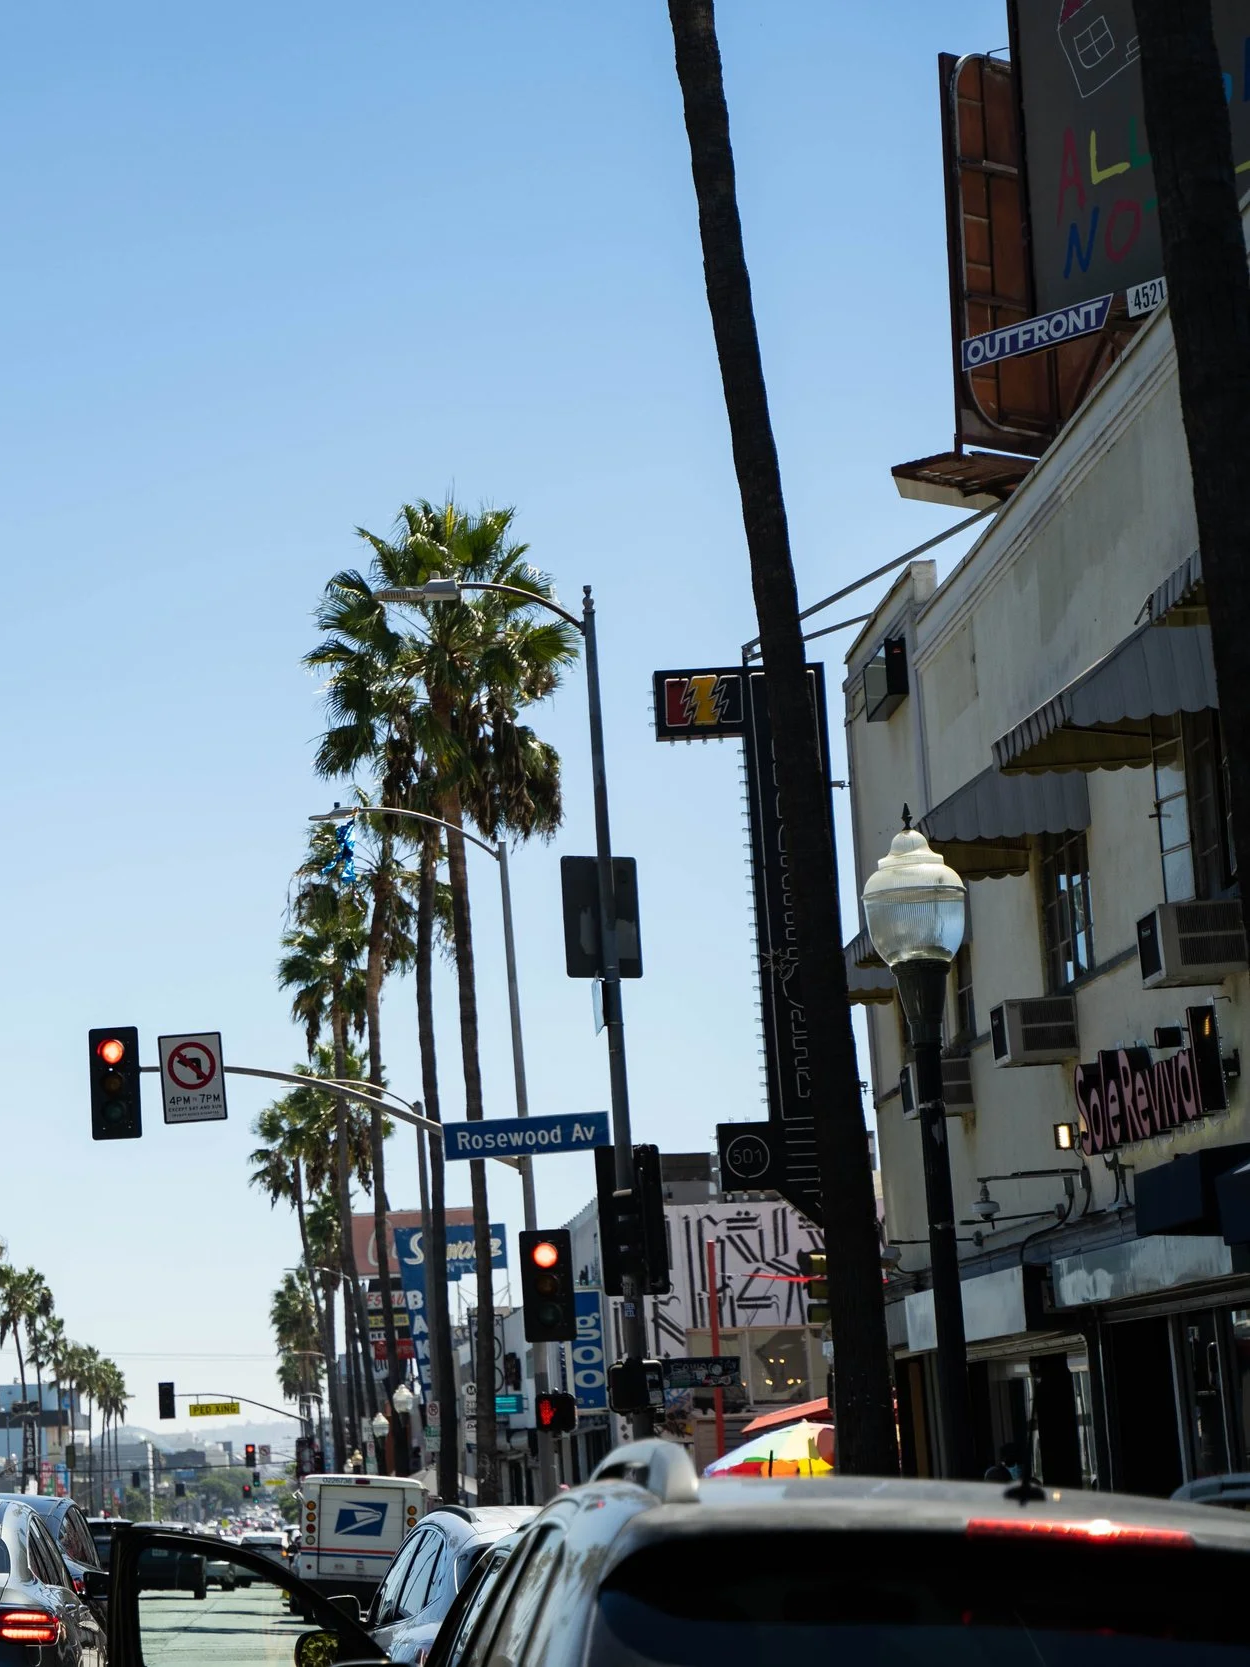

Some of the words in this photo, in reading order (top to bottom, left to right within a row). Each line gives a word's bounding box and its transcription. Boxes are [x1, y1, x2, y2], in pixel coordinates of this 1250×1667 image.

[1064, 198, 1158, 280] NO
[1134, 280, 1166, 310] 4521
[967, 300, 1104, 364] OUTFRONT
[1074, 1050, 1121, 1156] Sole
[1117, 1008, 1203, 1142] Revival
[169, 1096, 191, 1106] 4PM
[199, 1093, 221, 1103] 7PM
[457, 1125, 562, 1150] Rosewood
[571, 1123, 596, 1142] Av
[732, 1148, 762, 1165] 501
[193, 1405, 211, 1414] PED
[215, 1404, 238, 1413] XING
